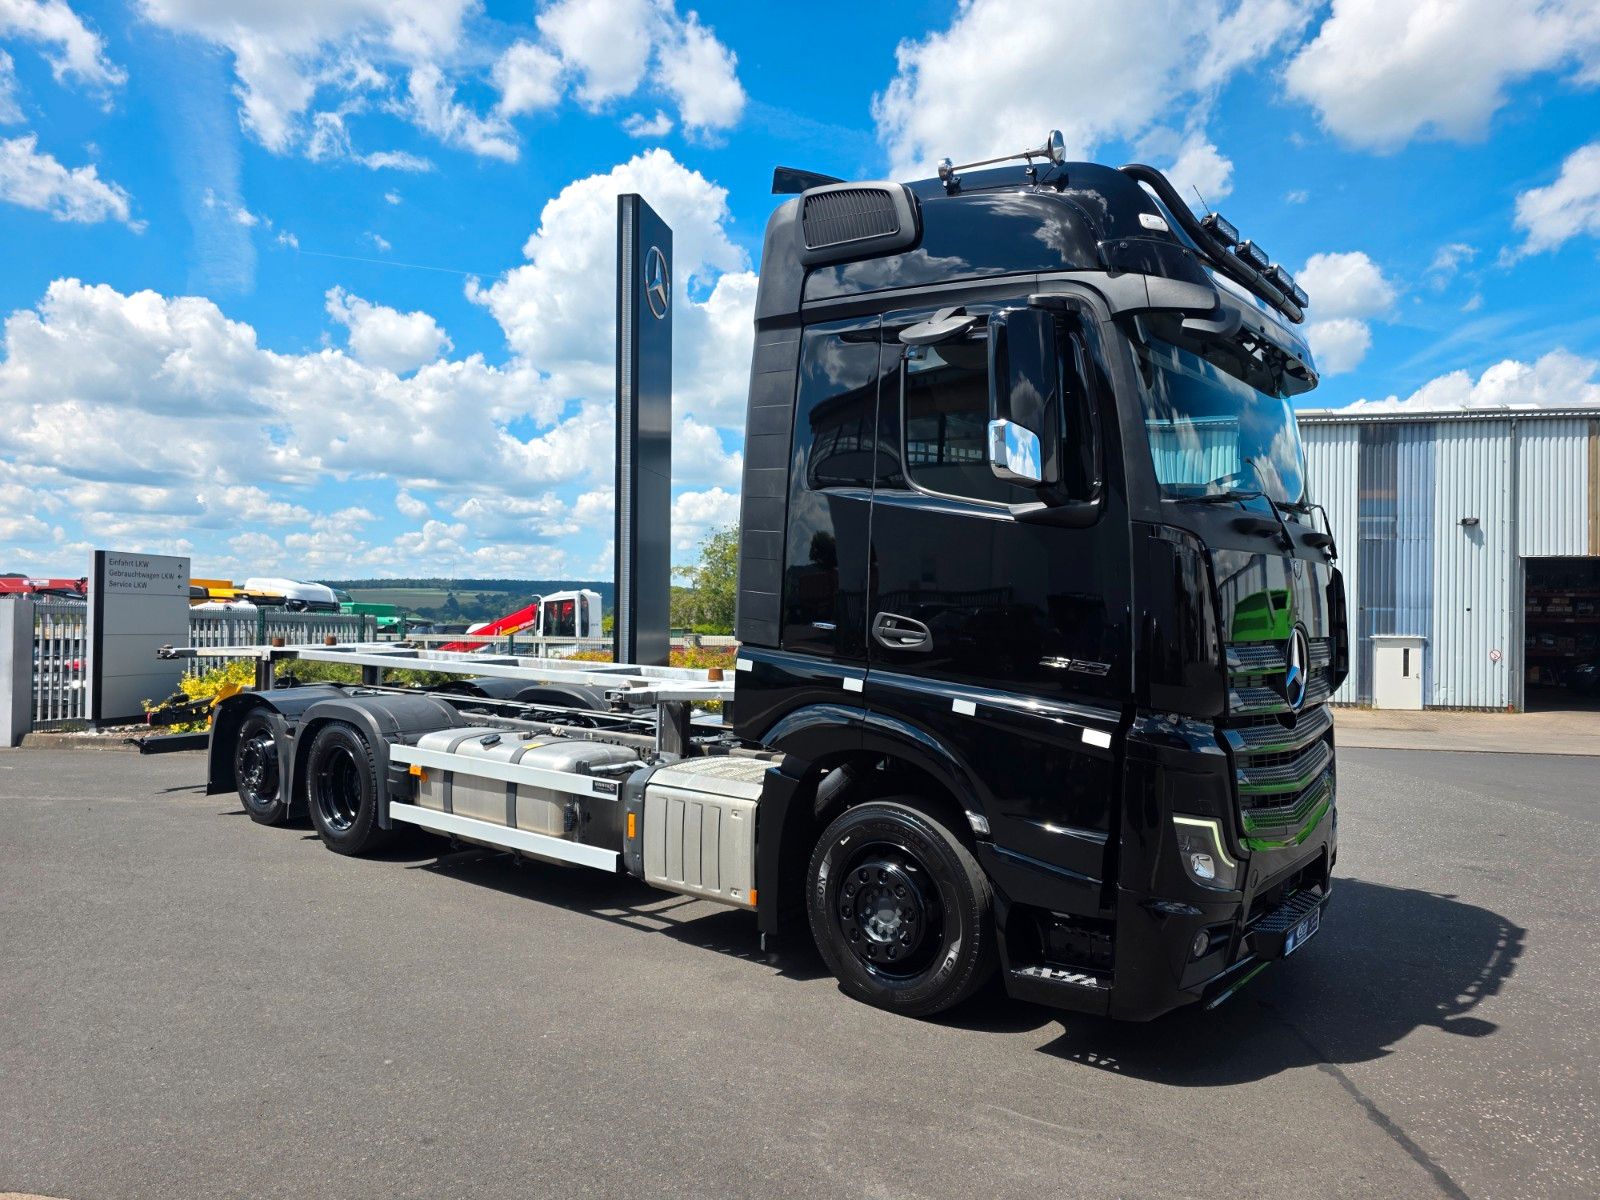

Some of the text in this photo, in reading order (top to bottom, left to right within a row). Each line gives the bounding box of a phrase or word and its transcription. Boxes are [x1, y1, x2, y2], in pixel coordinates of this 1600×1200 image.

[109, 558, 150, 568] Einfahrt LKW
[109, 569, 175, 580] Gebrauchtwagen LKW
[109, 580, 148, 589] Service LKW
